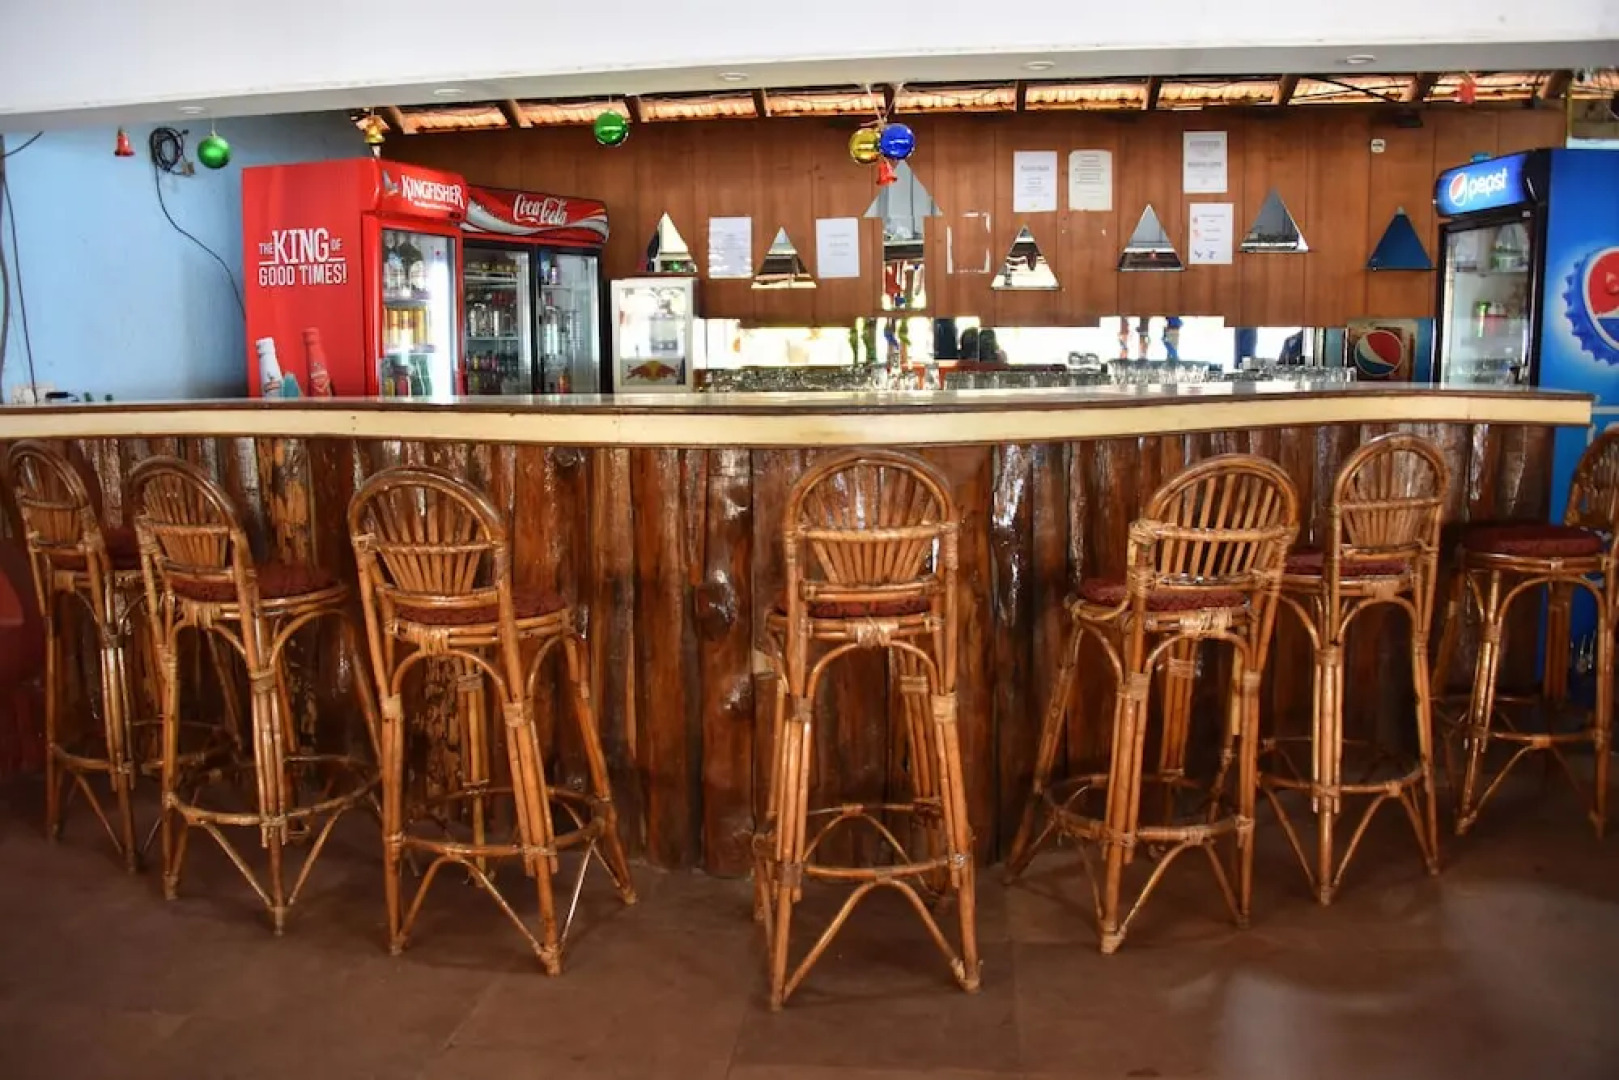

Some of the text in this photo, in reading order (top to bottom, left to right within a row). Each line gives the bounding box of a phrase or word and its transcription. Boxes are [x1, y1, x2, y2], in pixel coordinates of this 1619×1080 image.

[401, 174, 465, 210] KINGFISHER
[1468, 167, 1508, 200] pepsi
[259, 228, 342, 264] THE KING OF
[259, 263, 348, 287] GOOD TIMES!
